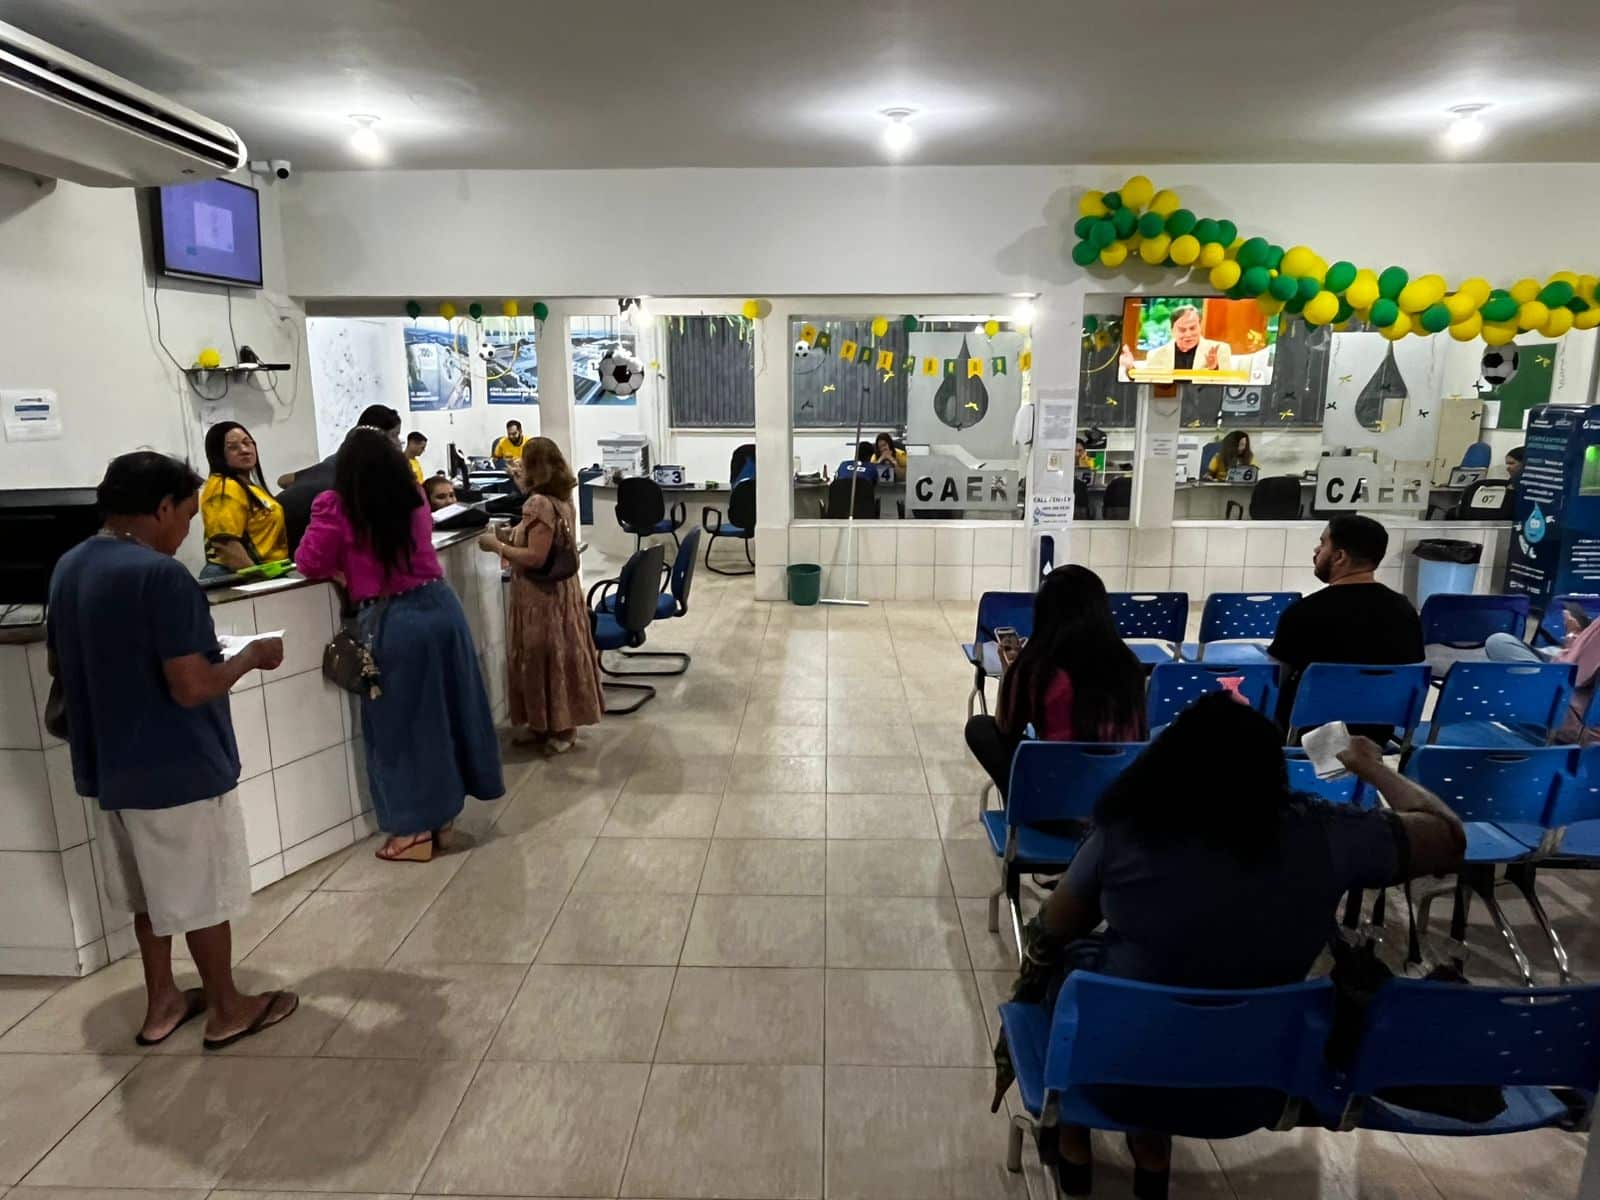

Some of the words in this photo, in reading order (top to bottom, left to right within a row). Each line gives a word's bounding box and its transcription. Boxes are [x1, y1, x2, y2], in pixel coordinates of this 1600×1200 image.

[672, 470, 682, 484] 3
[1243, 469, 1252, 481] 6
[1481, 495, 1496, 505] 07
